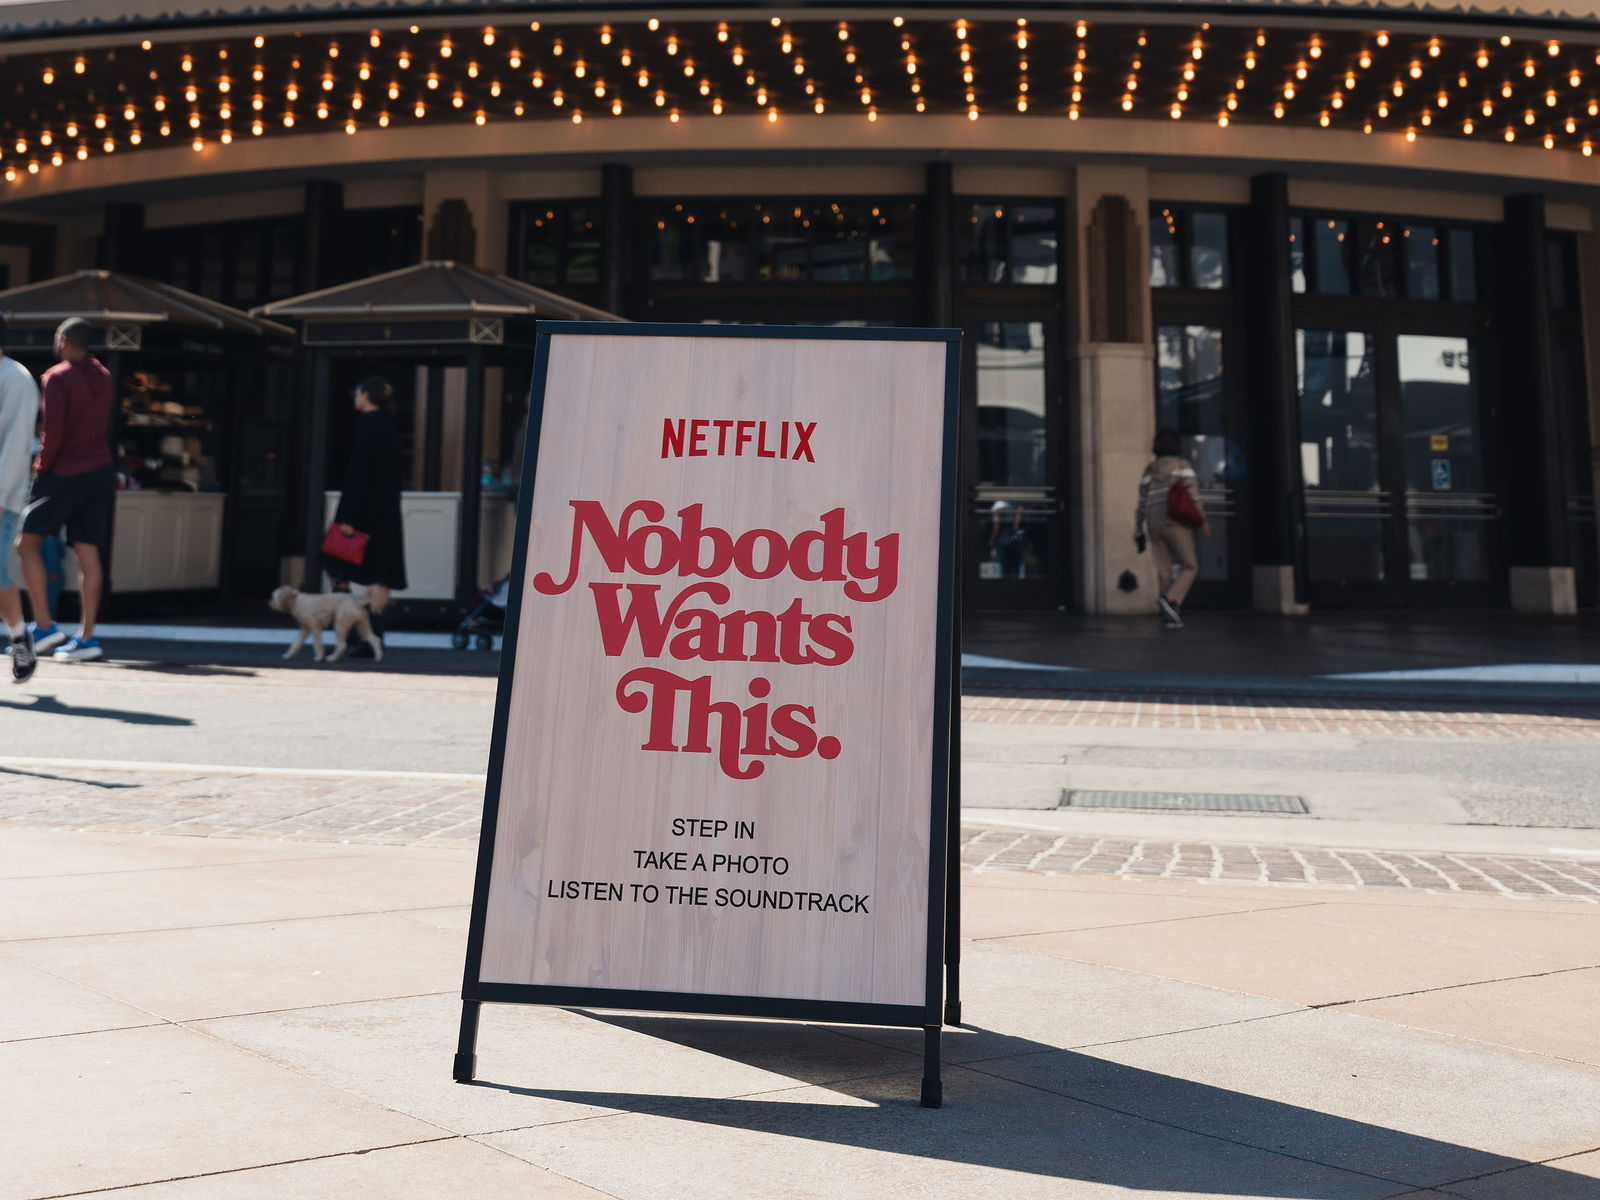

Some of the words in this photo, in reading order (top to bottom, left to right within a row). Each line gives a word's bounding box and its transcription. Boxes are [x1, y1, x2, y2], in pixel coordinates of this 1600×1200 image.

[661, 418, 818, 464] NETFLIX
[533, 500, 900, 603] Nobody
[588, 581, 854, 667] Wants
[616, 667, 841, 780] This.
[671, 817, 729, 838] STEP
[734, 820, 755, 840] IN
[633, 850, 688, 871] TAKE
[691, 853, 708, 872] A
[712, 853, 789, 876] PHOTO
[547, 879, 624, 902] LISTEN
[629, 883, 660, 904] TO
[665, 885, 709, 906] THE
[714, 888, 870, 914] SOUNDTRACK
